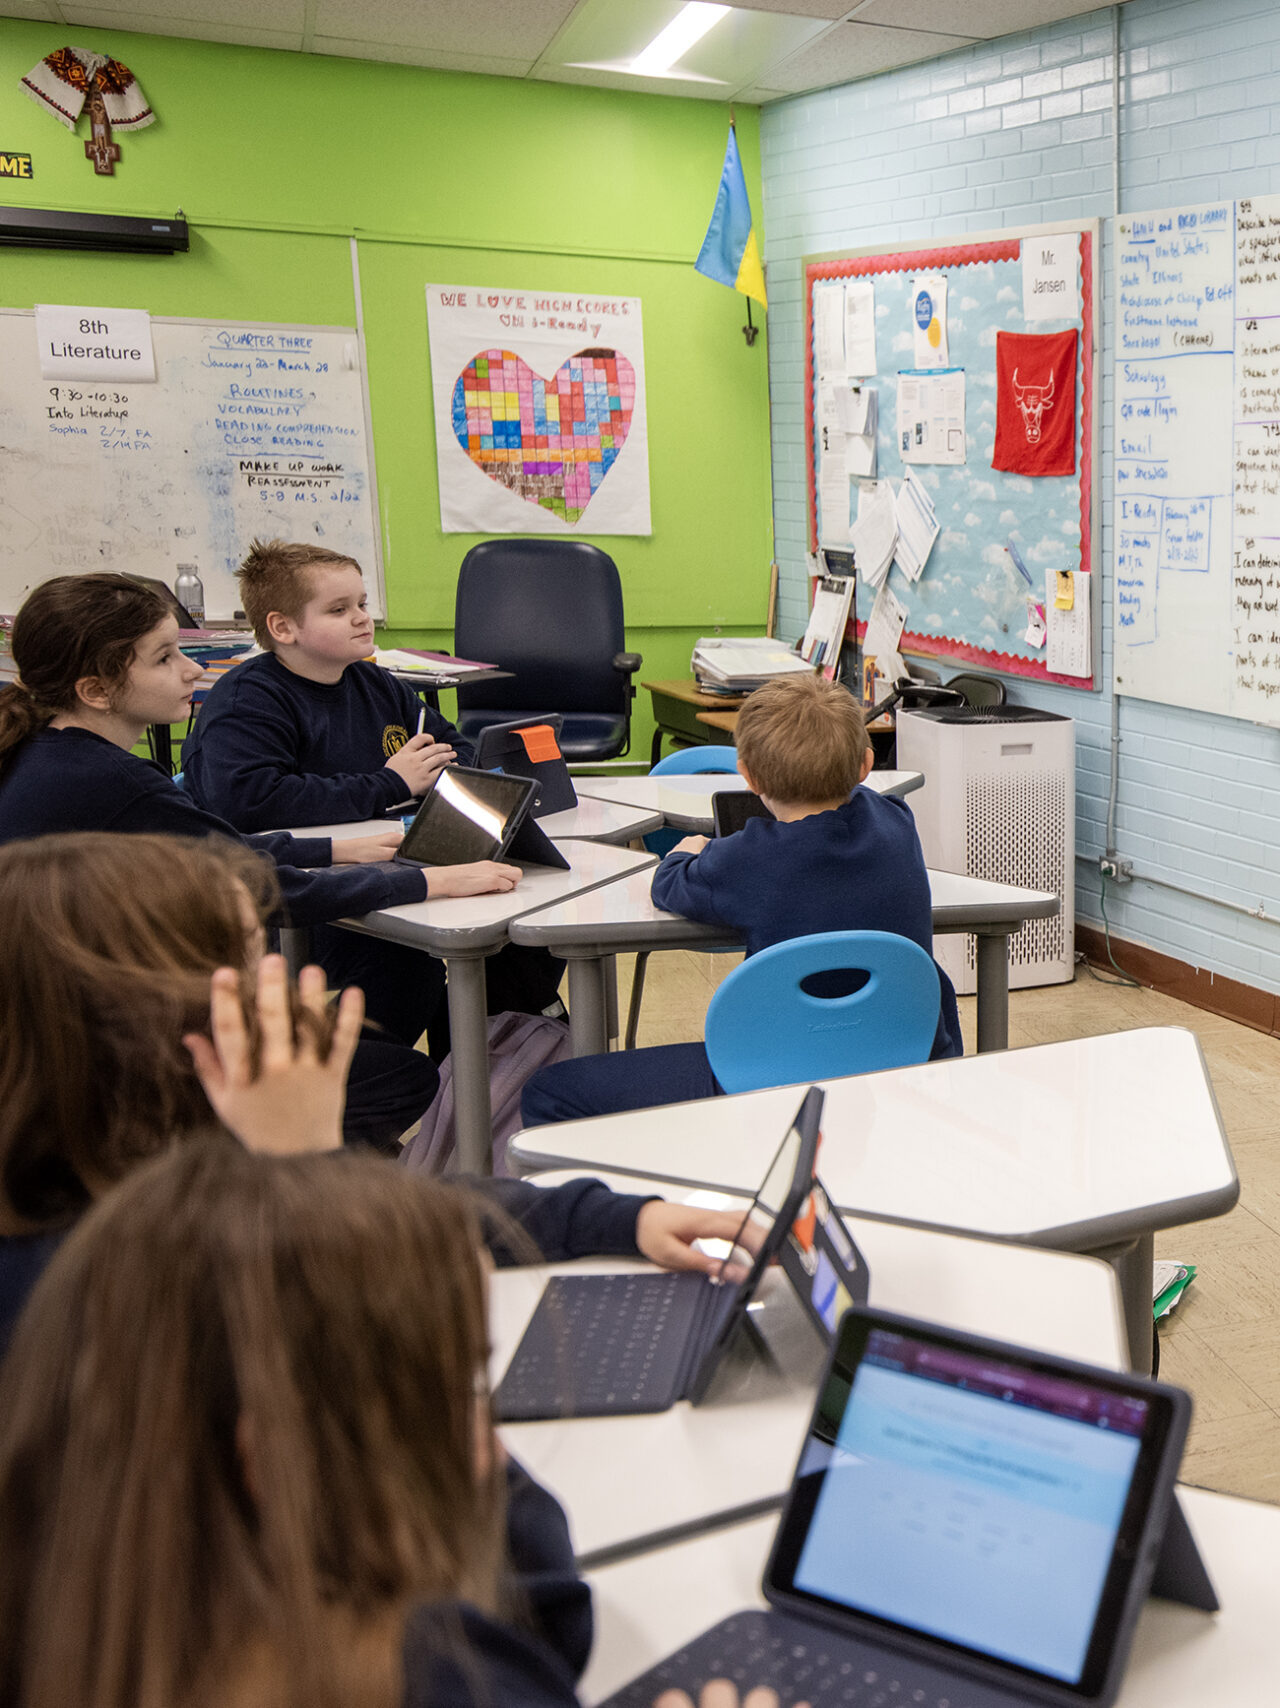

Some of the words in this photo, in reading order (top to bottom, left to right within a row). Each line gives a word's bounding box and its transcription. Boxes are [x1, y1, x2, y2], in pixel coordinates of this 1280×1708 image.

[1041, 250, 1056, 266] Mr.
[1033, 278, 1066, 294] Jansen
[441, 293, 467, 308] WE
[477, 295, 527, 311] LOVE
[576, 299, 630, 315] SCORES
[79, 319, 109, 334] 8th
[532, 317, 601, 339] i-Ready
[217, 331, 274, 348] QUARTER
[279, 335, 313, 348] THREE
[51, 342, 142, 360] Literature
[201, 352, 252, 377] January
[278, 359, 310, 372] March
[315, 362, 329, 373] 28
[49, 387, 83, 401] 9:30
[230, 383, 304, 399] ROUTINES
[46, 406, 74, 419] Into
[217, 404, 304, 417] VOCABULARY
[49, 424, 88, 439] Sophia
[215, 418, 272, 432] READING
[276, 424, 360, 436] COMPREHENSION
[224, 434, 263, 445] CLOSE
[272, 436, 324, 448] READING
[1121, 434, 1151, 454] Email
[240, 461, 279, 472] MAKE
[288, 462, 304, 471] UP
[312, 463, 344, 473] WORK
[247, 475, 331, 488] REASSESSMENT
[260, 490, 285, 501] 5-8
[1234, 552, 1241, 568] I
[1243, 558, 1256, 569] can
[1266, 573, 1274, 588] of
[1233, 627, 1242, 644] I
[1248, 632, 1263, 645] can
[1236, 651, 1256, 669] parts
